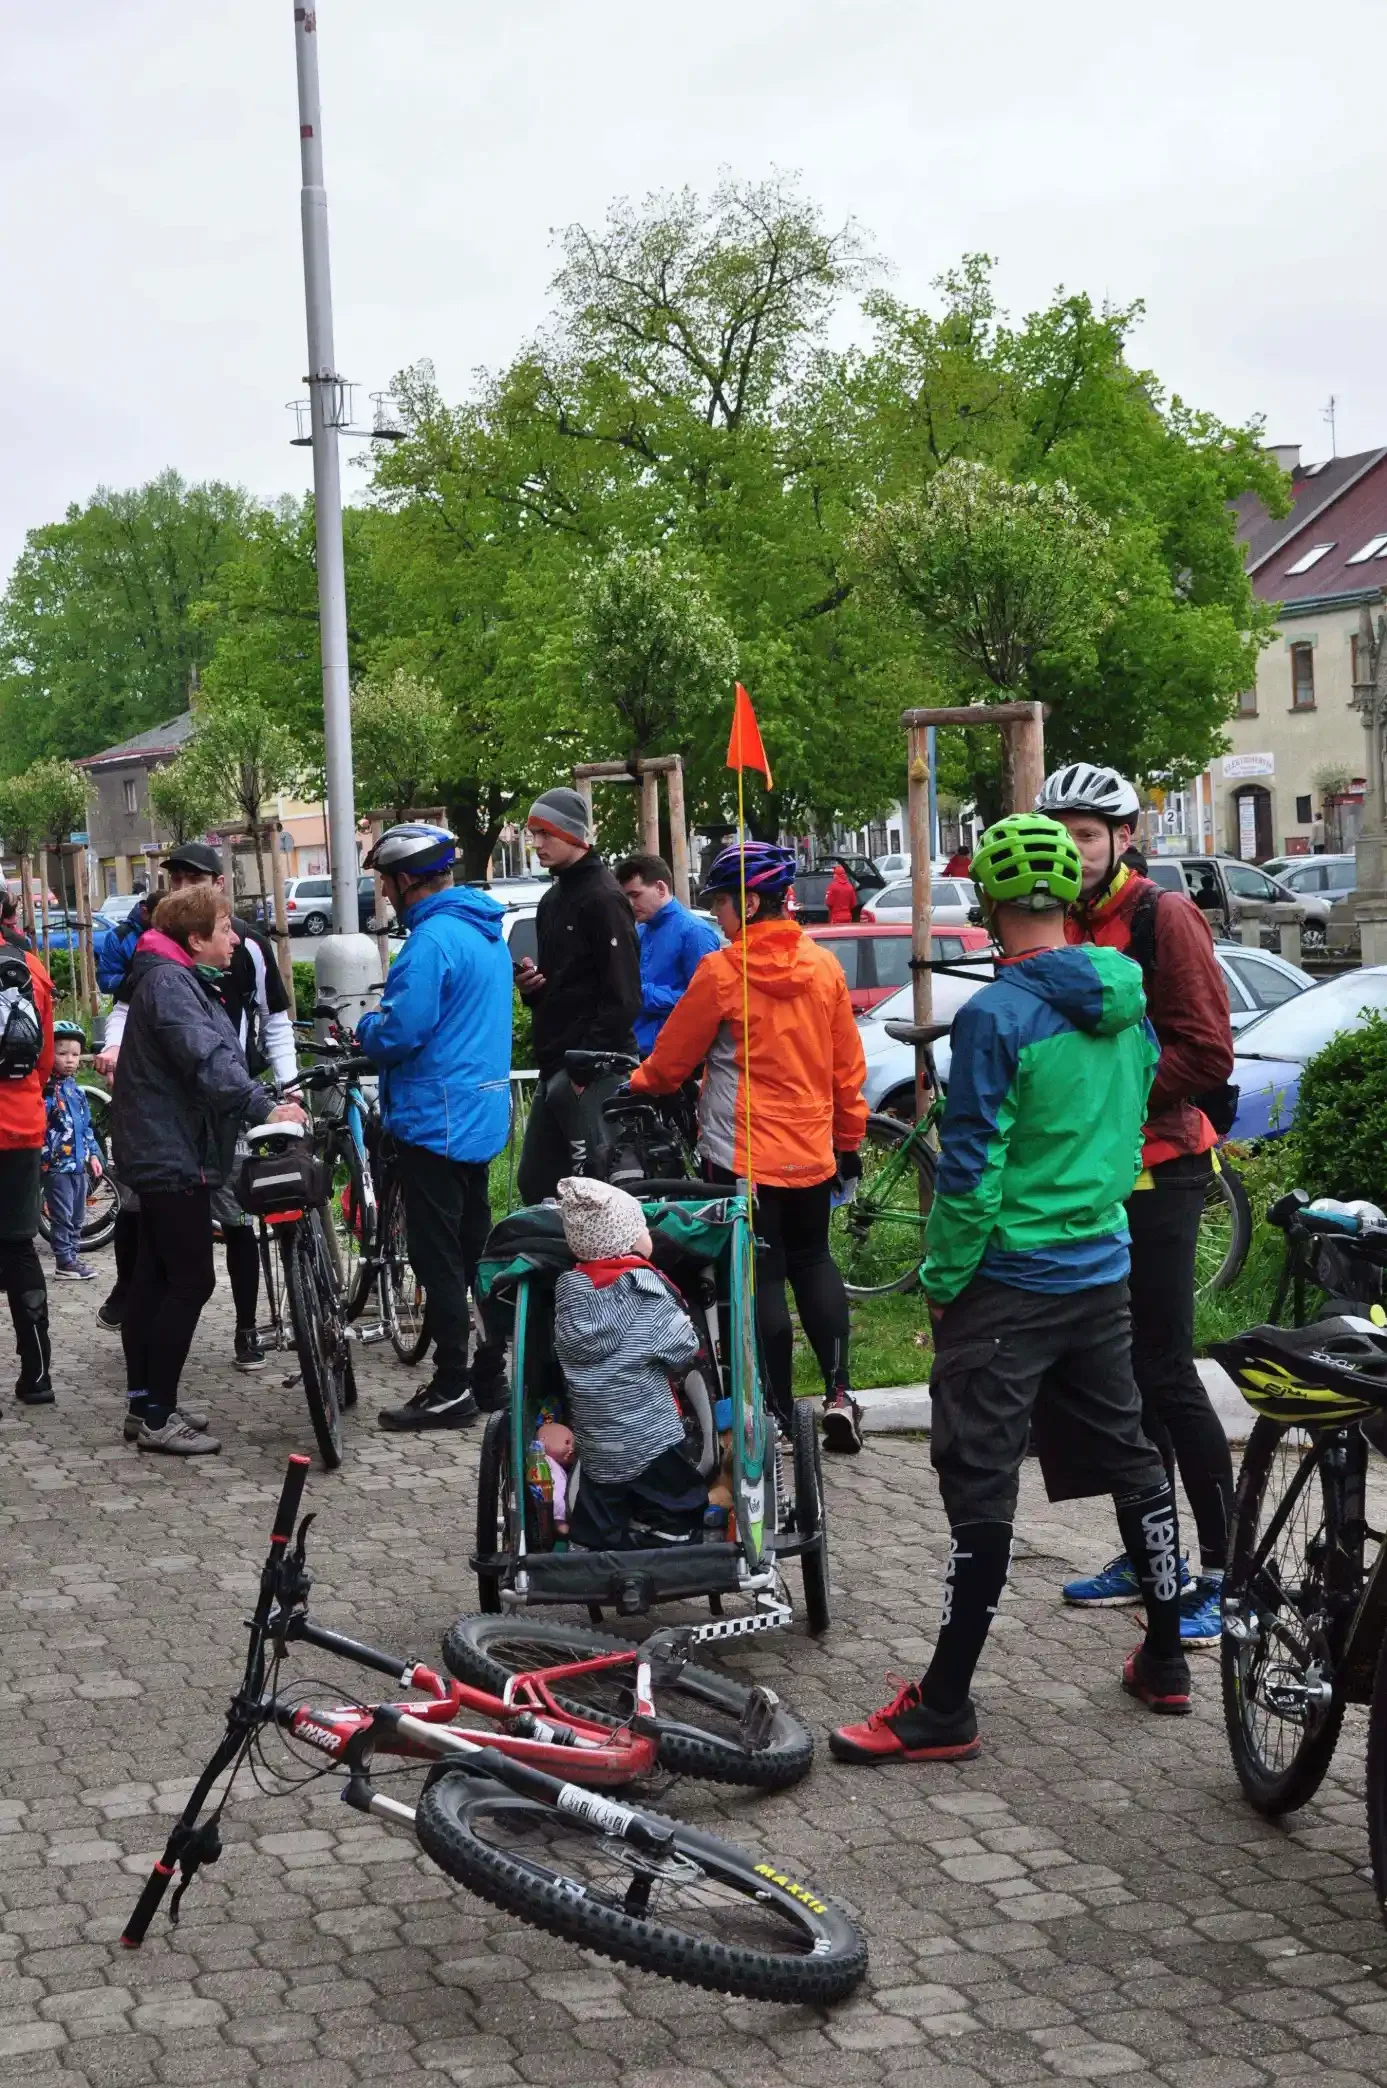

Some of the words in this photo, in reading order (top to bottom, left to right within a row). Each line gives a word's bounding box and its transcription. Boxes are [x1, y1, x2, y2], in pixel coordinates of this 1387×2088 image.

[1167, 812, 1175, 822] 2
[1308, 1350, 1358, 1370] FORCE
[1141, 1505, 1177, 1602] eleven
[753, 1864, 828, 1914] MAXXIS
